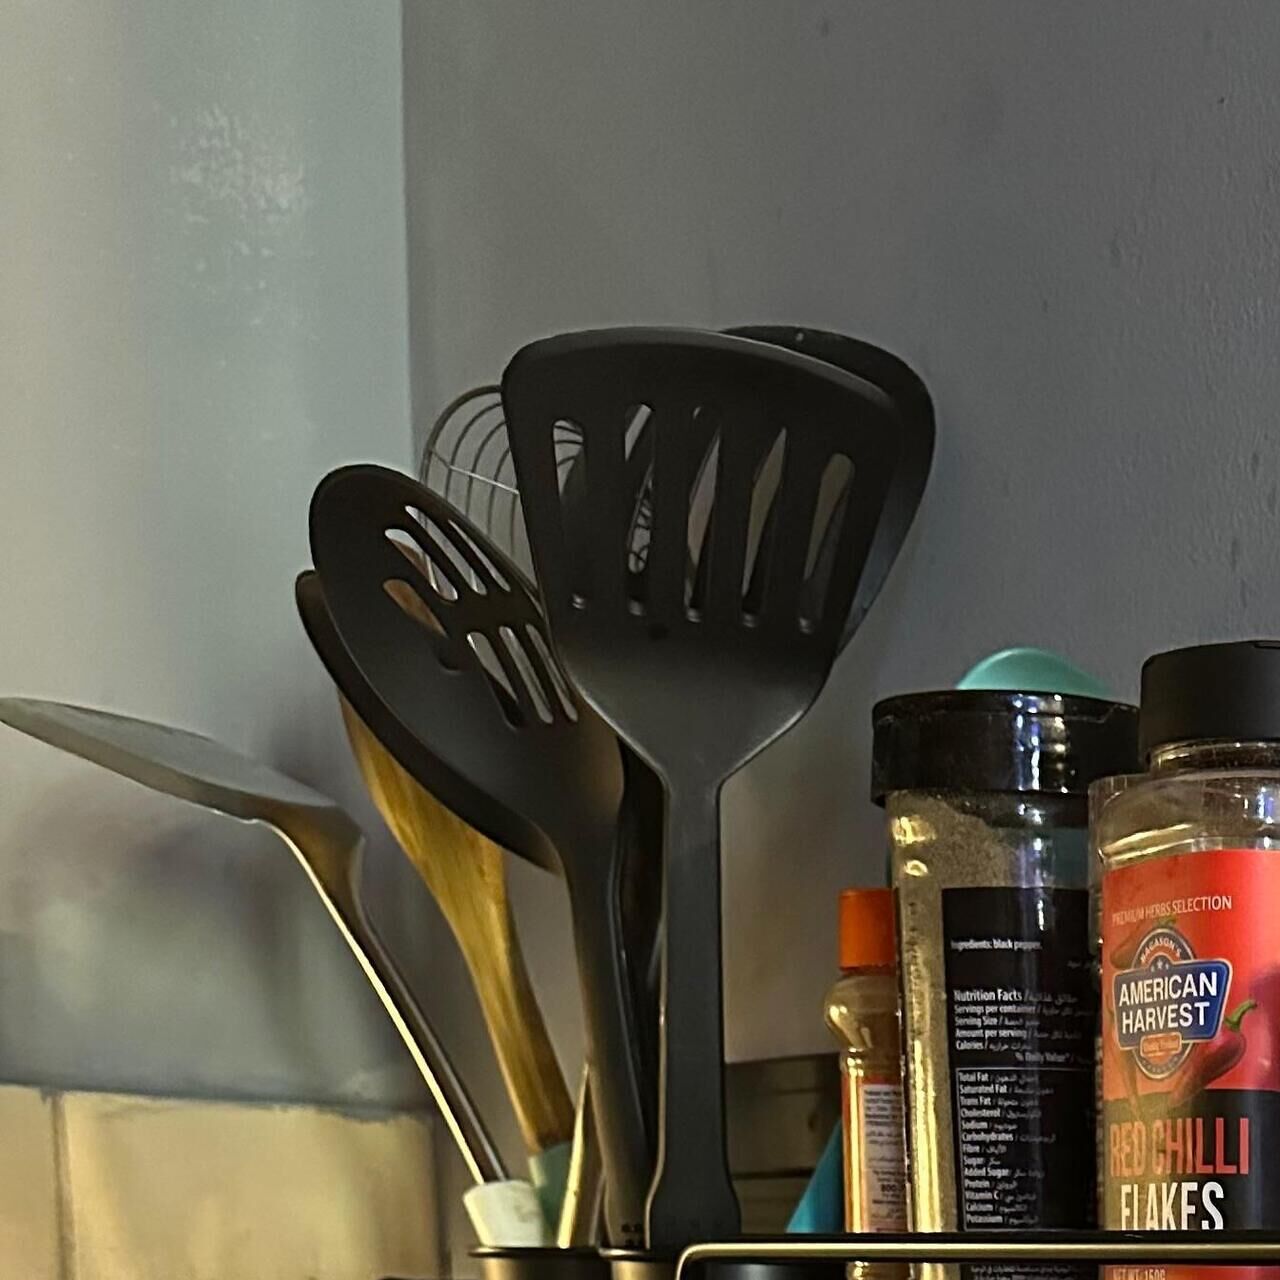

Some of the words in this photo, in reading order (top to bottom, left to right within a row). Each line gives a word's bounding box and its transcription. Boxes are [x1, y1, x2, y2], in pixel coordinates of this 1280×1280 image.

[1145, 901, 1171, 918] HERBS
[1172, 895, 1232, 915] SELECTION
[993, 938, 1013, 949] black
[954, 990, 996, 1001] Nutrition
[997, 988, 1022, 1001] Facts
[1119, 972, 1217, 1007] AMERICAN
[985, 1005, 998, 1015] per
[1122, 1001, 1210, 1034] HARVEST
[956, 1028, 984, 1038] Amount
[985, 1029, 998, 1039] per
[999, 1029, 1027, 1039] serving
[956, 1040, 984, 1050] Calories
[959, 1072, 976, 1082] Total
[977, 1071, 989, 1082] Fat
[959, 1084, 994, 1094] Saturated
[995, 1084, 1008, 1094] Fat
[979, 1096, 992, 1106] Fat
[961, 1108, 1001, 1118] Cholesterol
[961, 1120, 988, 1130] Sodium
[962, 1132, 1014, 1142] Carbohydrates
[1110, 1121, 1147, 1177] RED
[1151, 1117, 1250, 1175] CHILLI
[987, 1167, 1009, 1178] Sugar
[965, 1179, 990, 1188] Protein
[966, 1202, 994, 1212] Calcium
[1120, 1181, 1225, 1231] FLAKES
[966, 1213, 1003, 1223] Potassium
